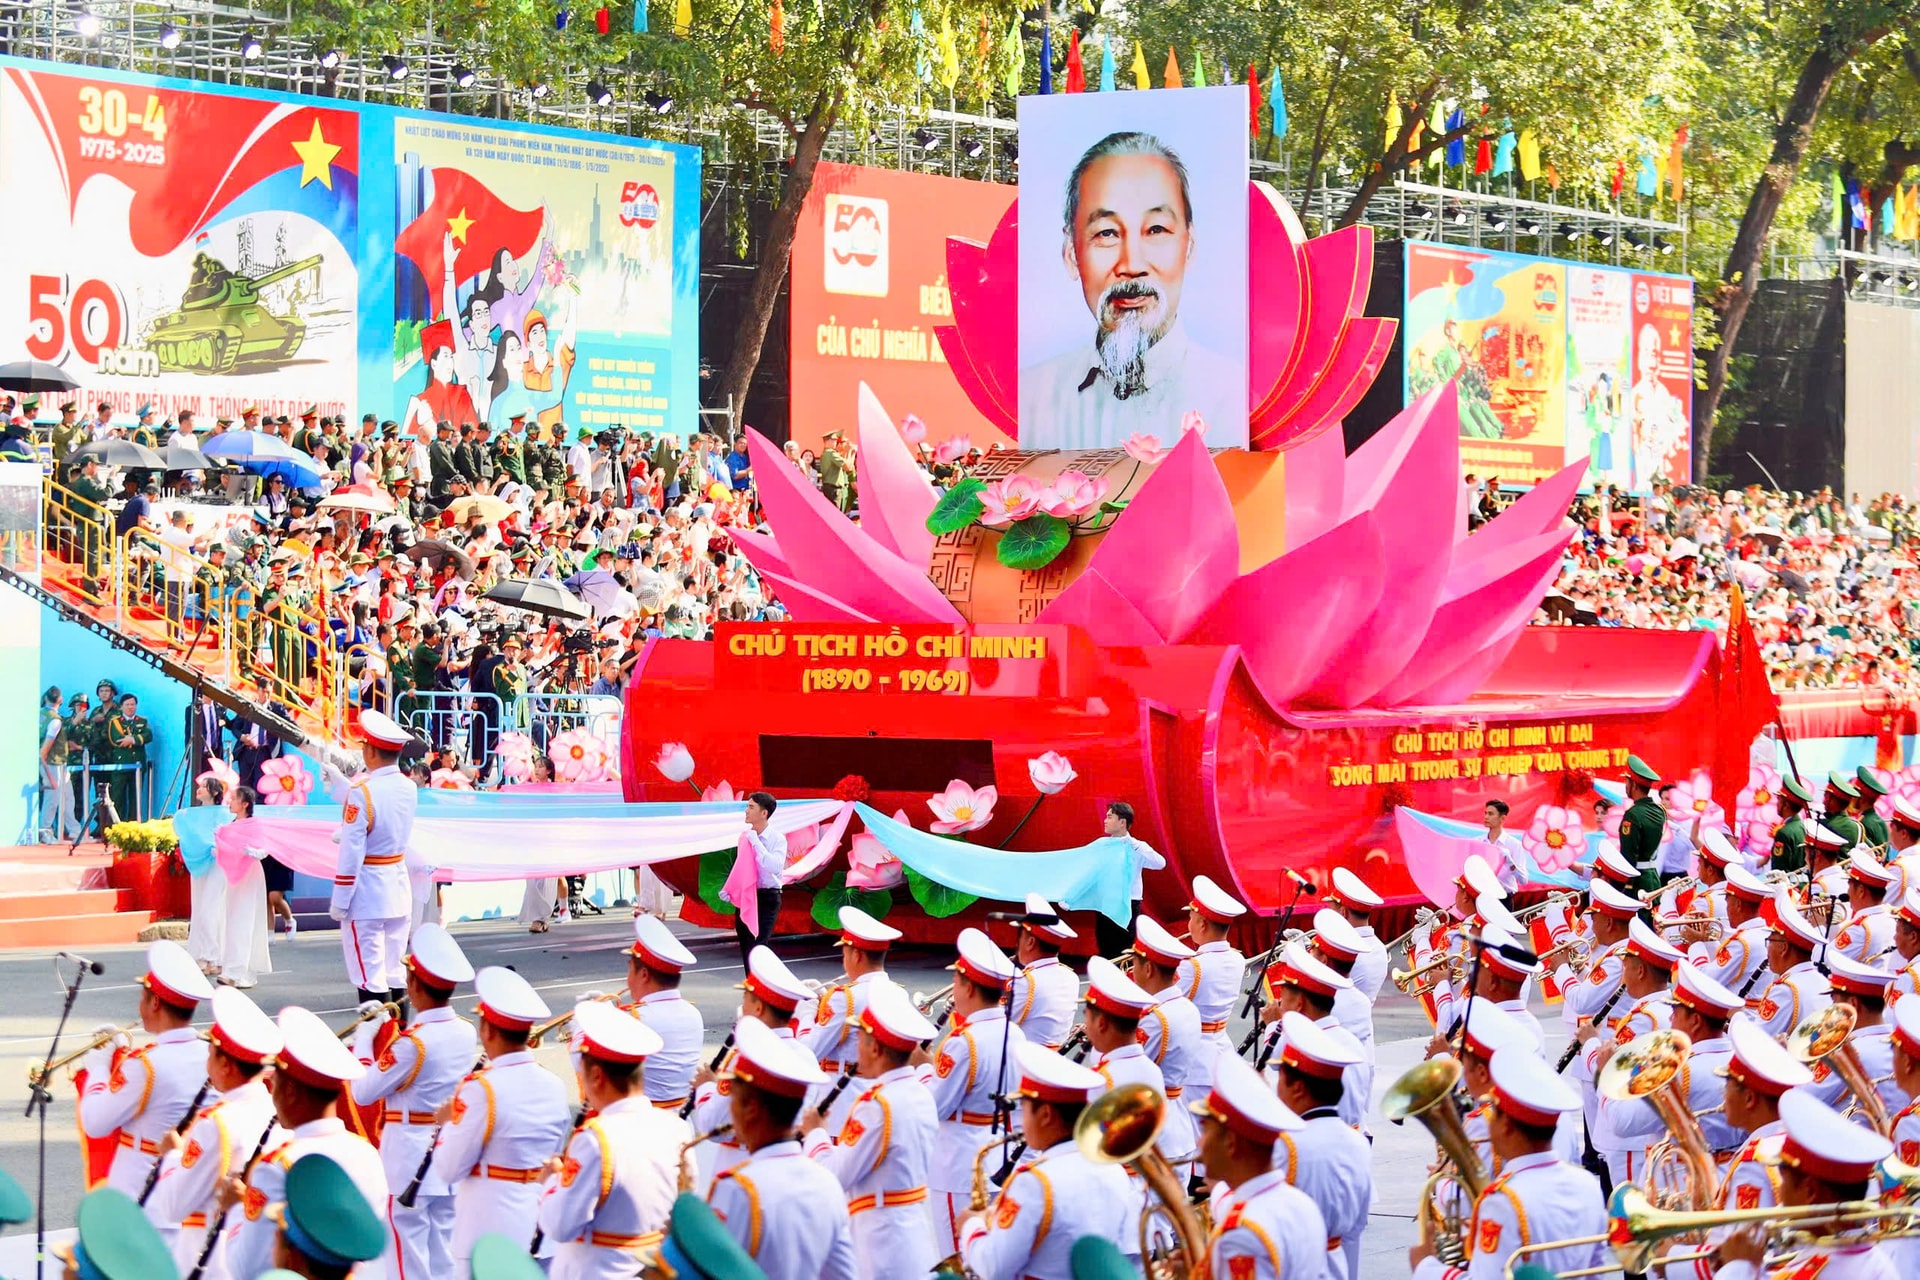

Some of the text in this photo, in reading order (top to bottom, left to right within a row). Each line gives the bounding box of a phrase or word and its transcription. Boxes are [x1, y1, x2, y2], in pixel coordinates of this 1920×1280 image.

[79, 86, 167, 142] 30-4
[79, 136, 166, 165] 1975-2025
[26, 275, 121, 364] 50
[817, 315, 847, 355] CỦA
[851, 319, 880, 358] CHỦ
[883, 326, 928, 362] NGHĨA
[729, 626, 1047, 662] CHỦ TỊCH HỒ CHÍ MINH
[802, 668, 971, 696] (1890 - 1969)
[1427, 731, 1459, 756] TỊCH
[1513, 727, 1547, 746] MINH
[1411, 760, 1459, 781] TRONG
[1612, 748, 1629, 767] TA
